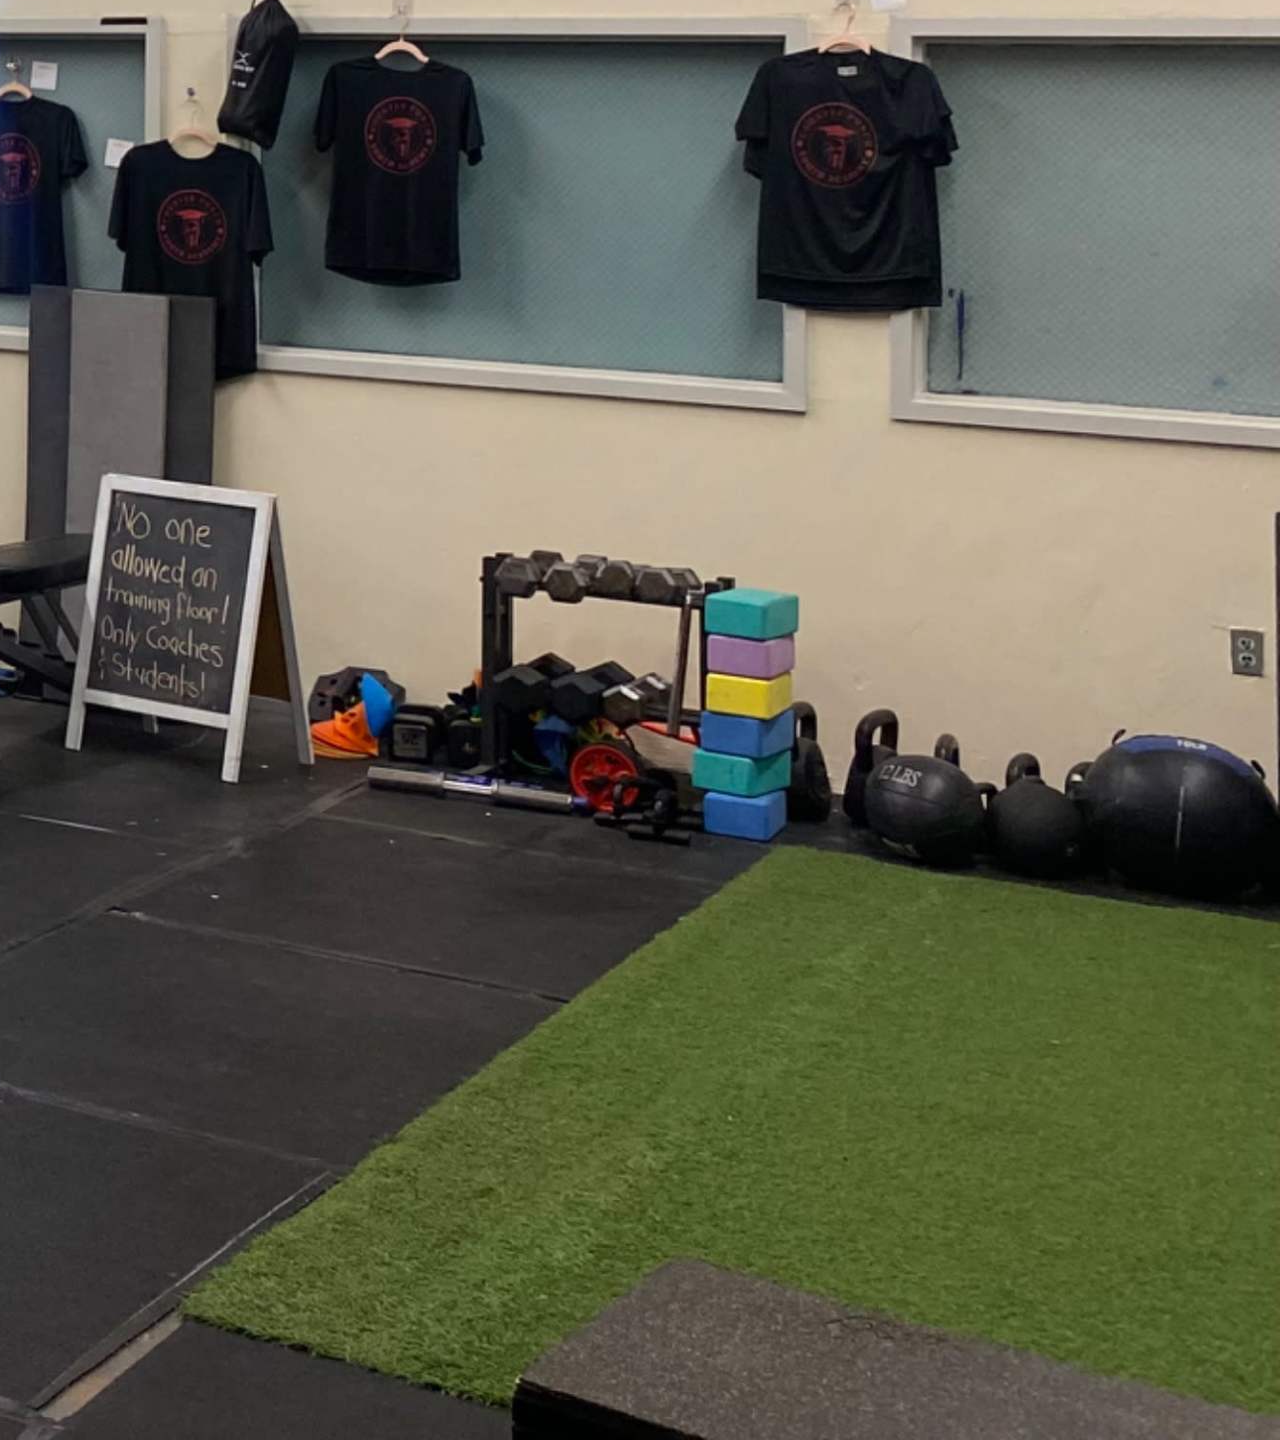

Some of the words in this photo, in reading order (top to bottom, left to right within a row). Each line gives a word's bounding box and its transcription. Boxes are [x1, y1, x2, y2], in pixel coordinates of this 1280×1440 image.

[164, 517, 212, 548] one
[111, 543, 186, 589] allowed
[105, 576, 171, 626] training
[100, 614, 140, 654] Only
[146, 625, 224, 668] Coaches
[891, 766, 923, 788] LBS
